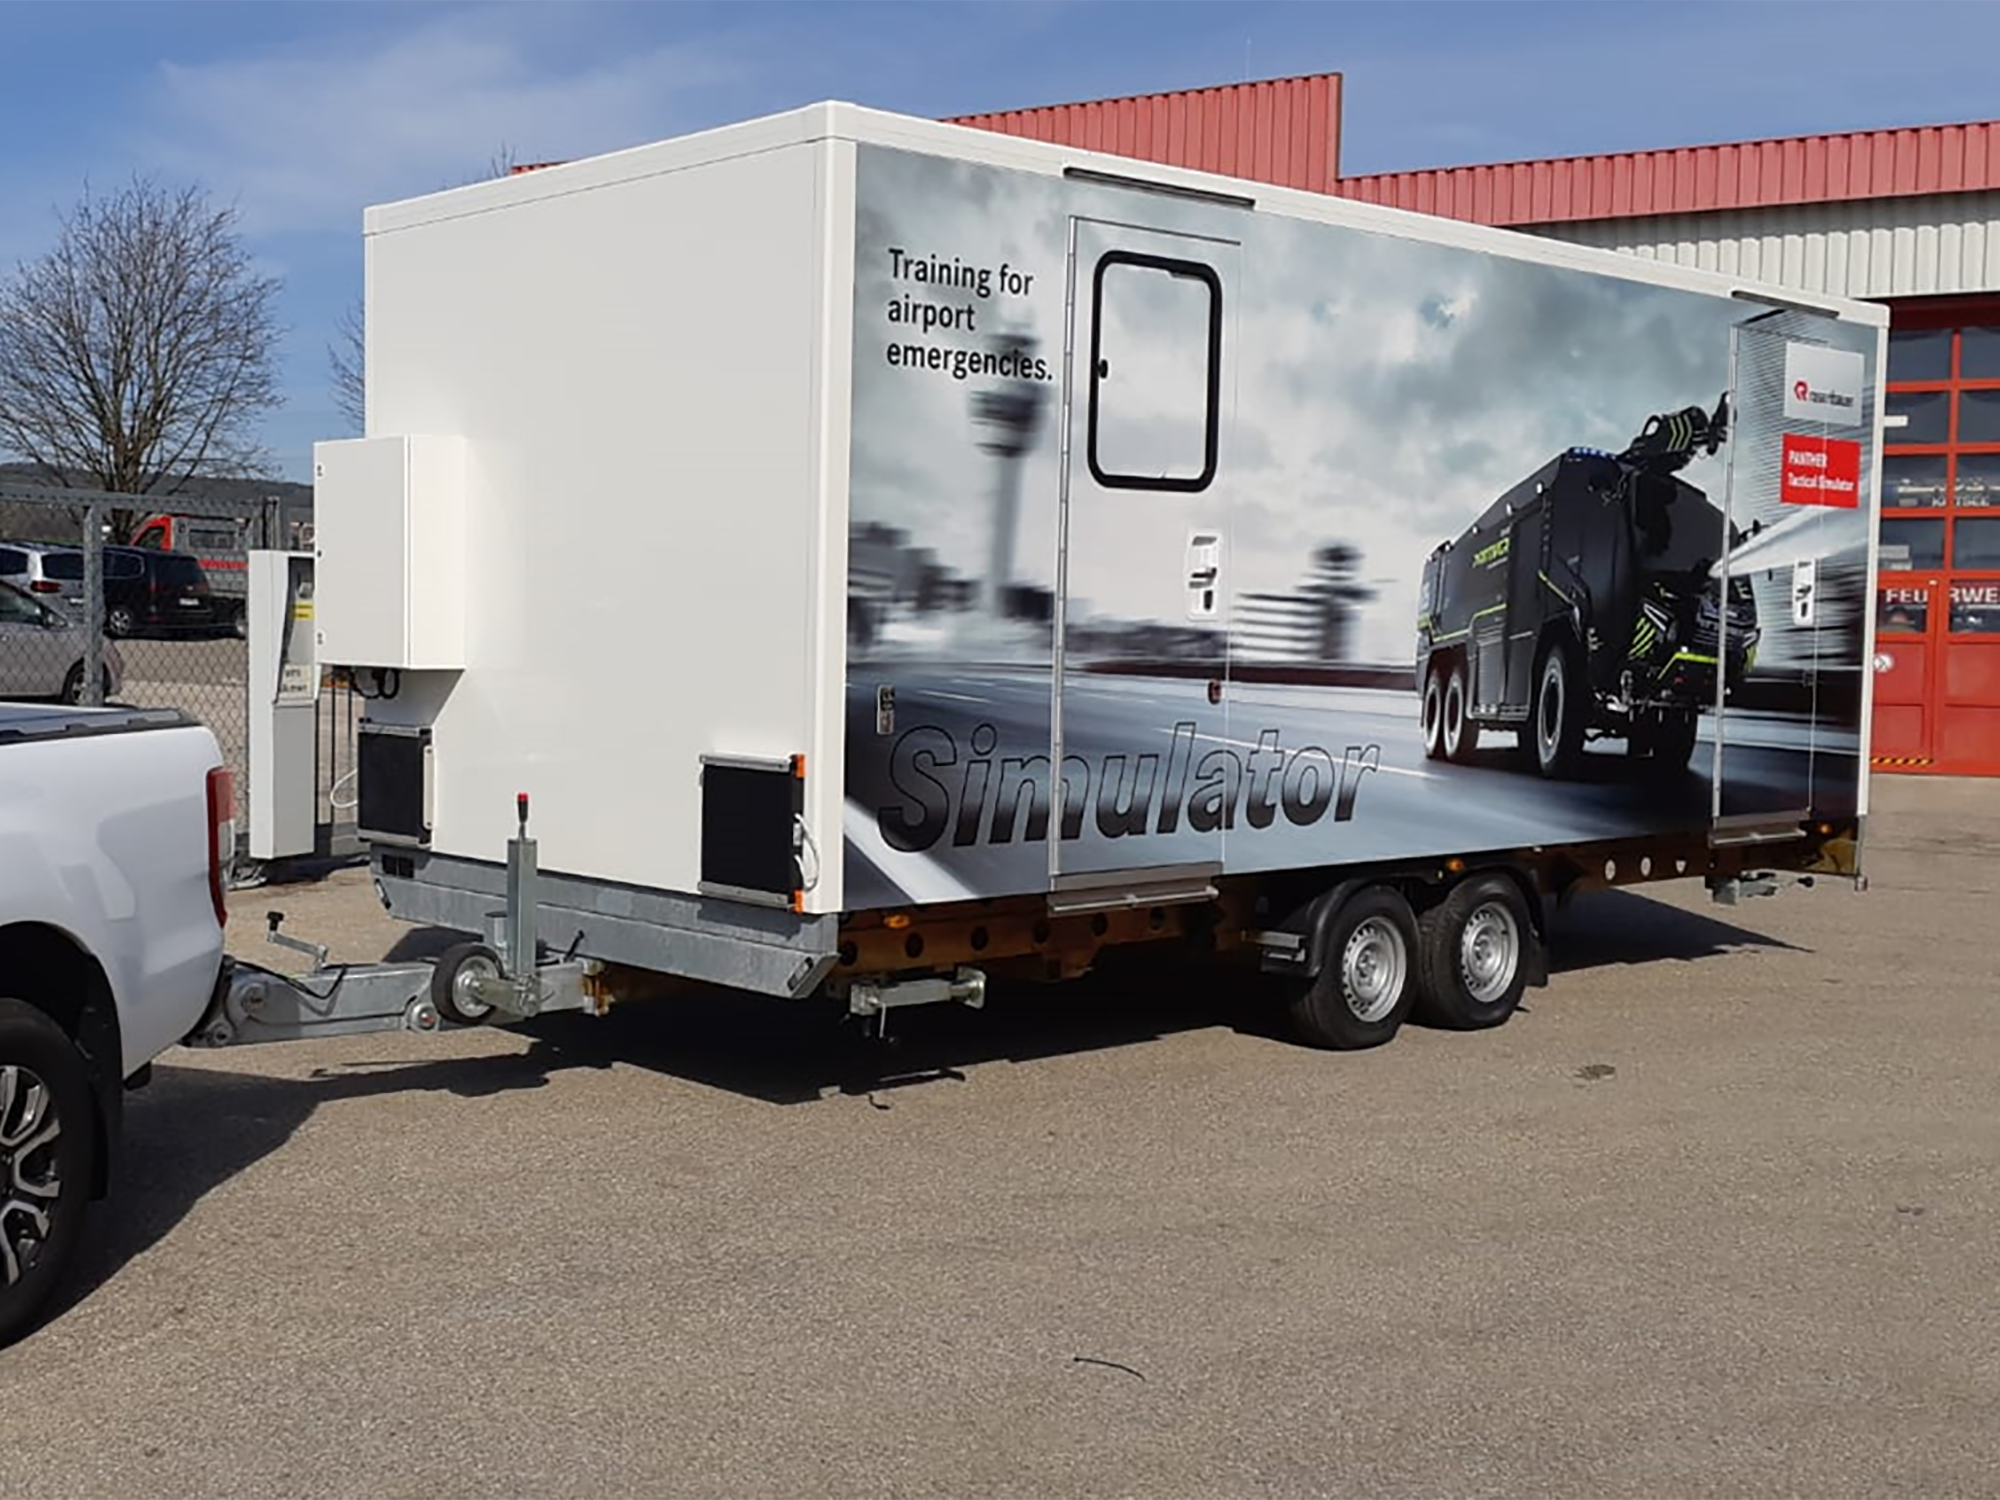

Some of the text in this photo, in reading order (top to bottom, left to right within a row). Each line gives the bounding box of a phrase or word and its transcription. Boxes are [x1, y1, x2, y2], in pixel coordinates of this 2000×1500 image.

[888, 248, 1033, 298] Training for
[888, 294, 975, 334] airport
[886, 343, 1053, 380] emergencies.
[1886, 587, 2000, 603] FEURWE
[877, 721, 1381, 853] Simulator
